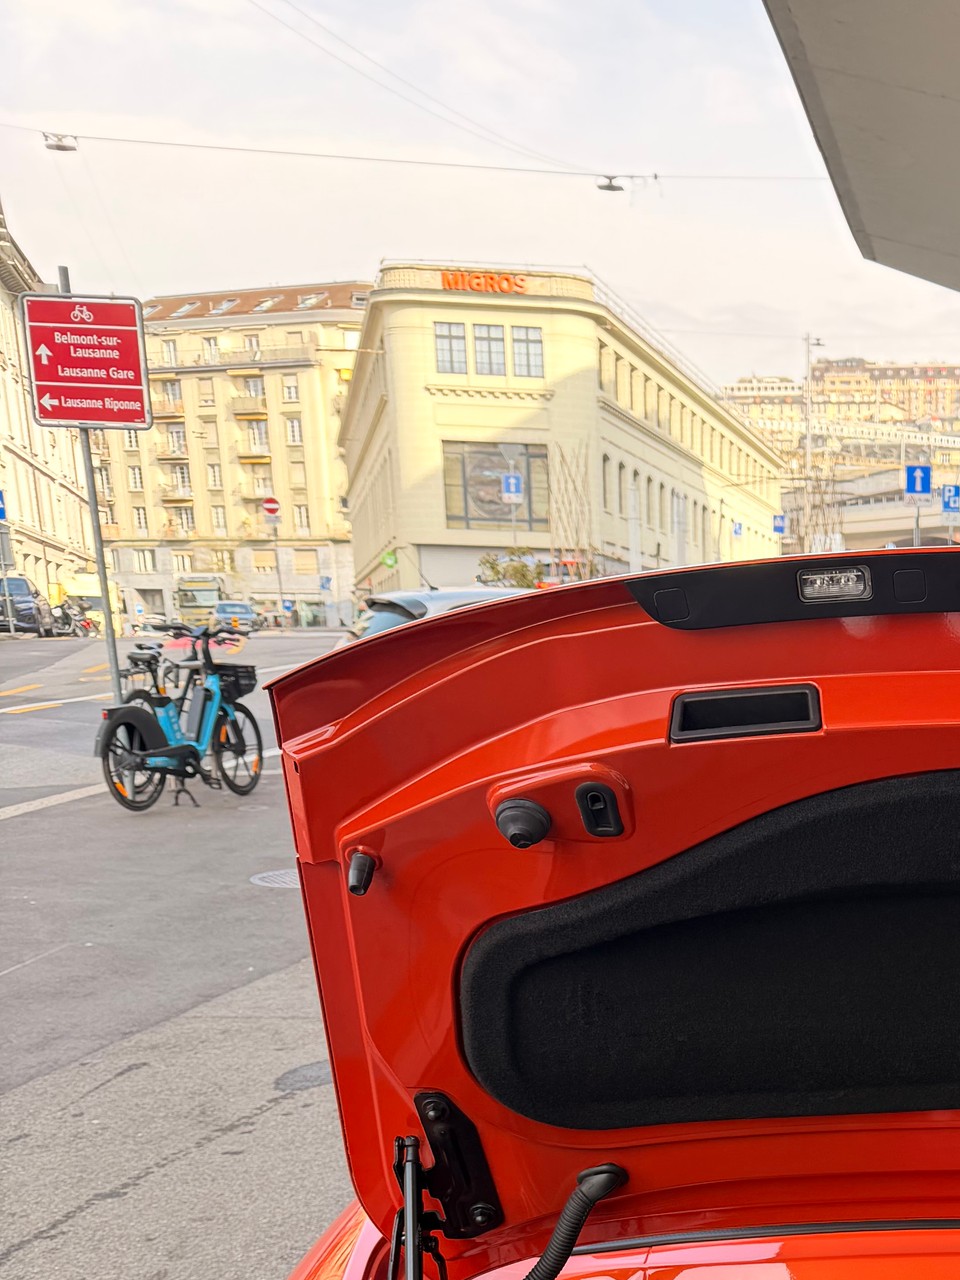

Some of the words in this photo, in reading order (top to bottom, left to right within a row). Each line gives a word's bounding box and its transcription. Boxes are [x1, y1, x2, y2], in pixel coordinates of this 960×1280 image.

[441, 270, 529, 295] MIGROS
[54, 332, 121, 346] Belmont-sur-
[70, 345, 120, 359] Lausanne
[57, 365, 107, 378] Lausanne
[109, 367, 135, 379] Gare
[60, 395, 103, 409] Lausanne
[104, 397, 142, 412] Riponne
